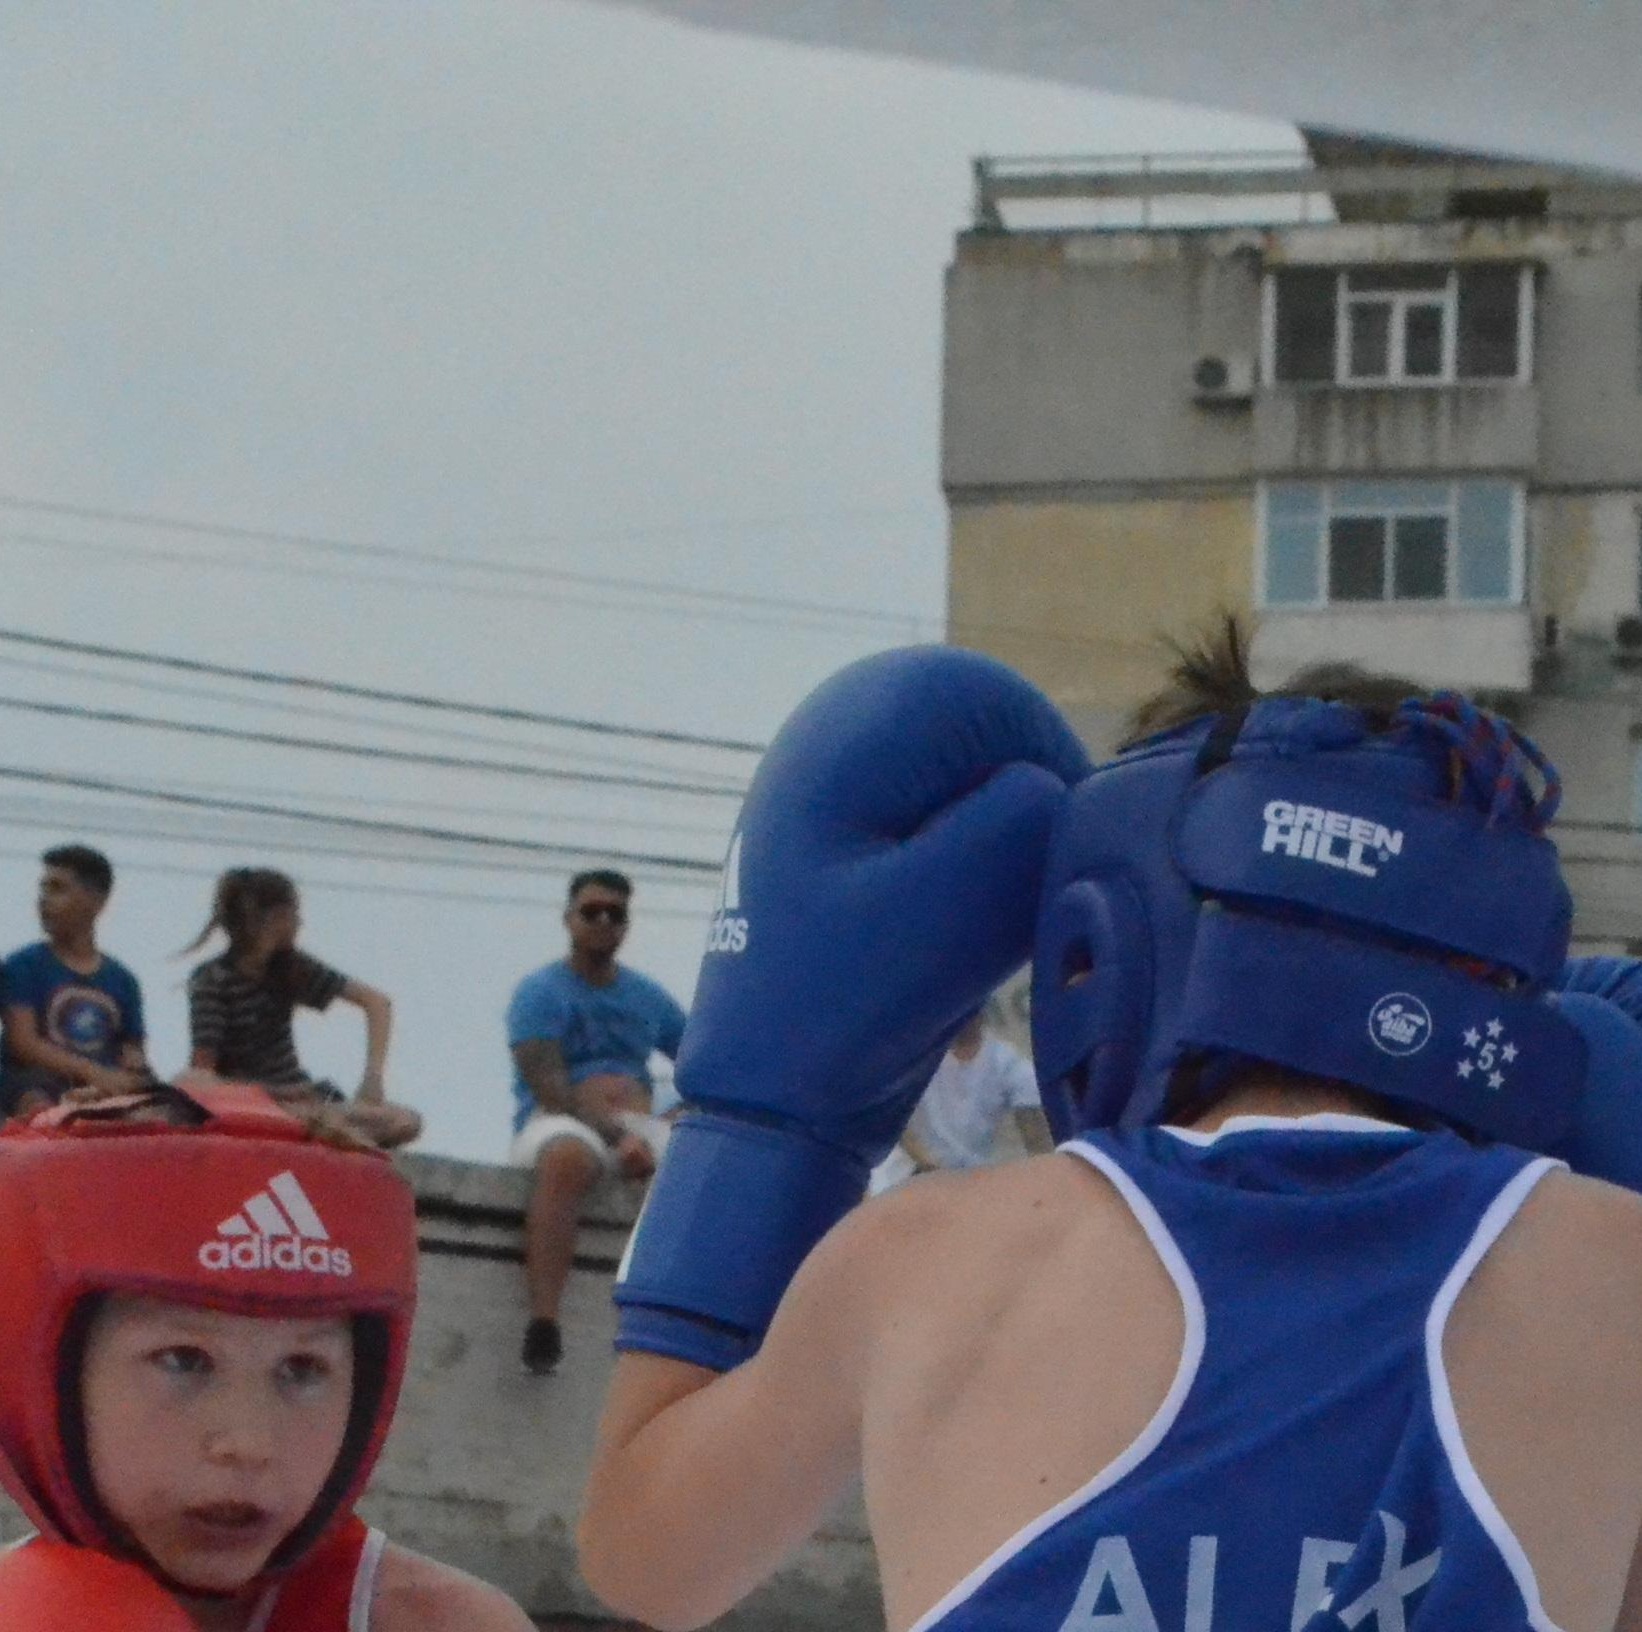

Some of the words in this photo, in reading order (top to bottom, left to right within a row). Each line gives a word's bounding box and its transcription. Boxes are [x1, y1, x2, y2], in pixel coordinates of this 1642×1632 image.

[1261, 823, 1378, 878] HILL
[1263, 799, 1404, 857] GREEN
[1477, 1041, 1498, 1071] 5
[199, 1233, 353, 1278] adidas
